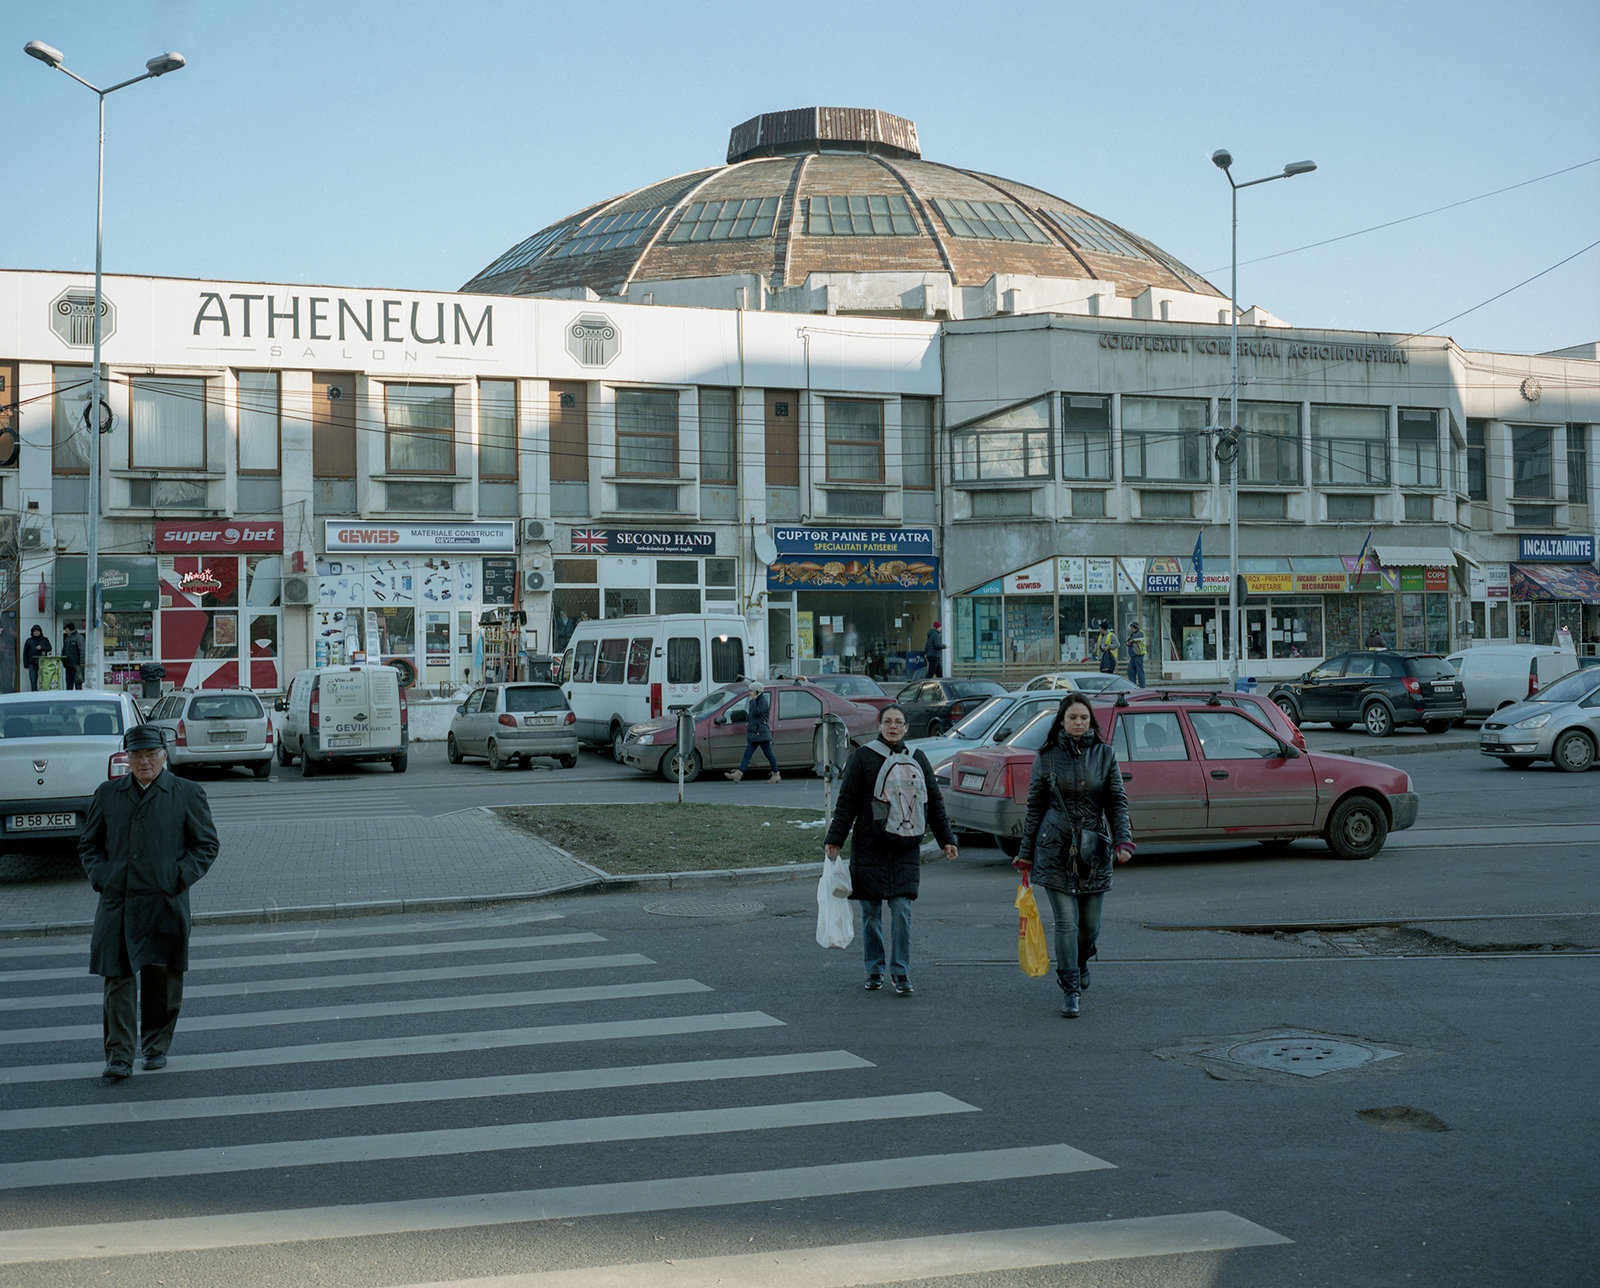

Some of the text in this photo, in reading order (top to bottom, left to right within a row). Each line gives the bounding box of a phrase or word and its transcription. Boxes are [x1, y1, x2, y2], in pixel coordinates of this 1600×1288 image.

[193, 292, 493, 346] ATHENEUM
[270, 345, 417, 361] SALON
[1099, 335, 1189, 353] COMPLEXUL
[1287, 343, 1409, 364] AGROINDUSTRIAL
[163, 528, 276, 545] super bet
[616, 533, 712, 546] SECOND HAND
[776, 531, 930, 543] CUPTOR PAINE PE VATRA
[814, 543, 898, 552] SPECIALITATI PATISERIE
[1523, 539, 1591, 556] INCALTAMINTE
[1148, 576, 1180, 585] GEVIK
[1251, 583, 1283, 591] PAPETARIE
[336, 724, 369, 732] GEVIK
[15, 814, 72, 827] B 58 XER
